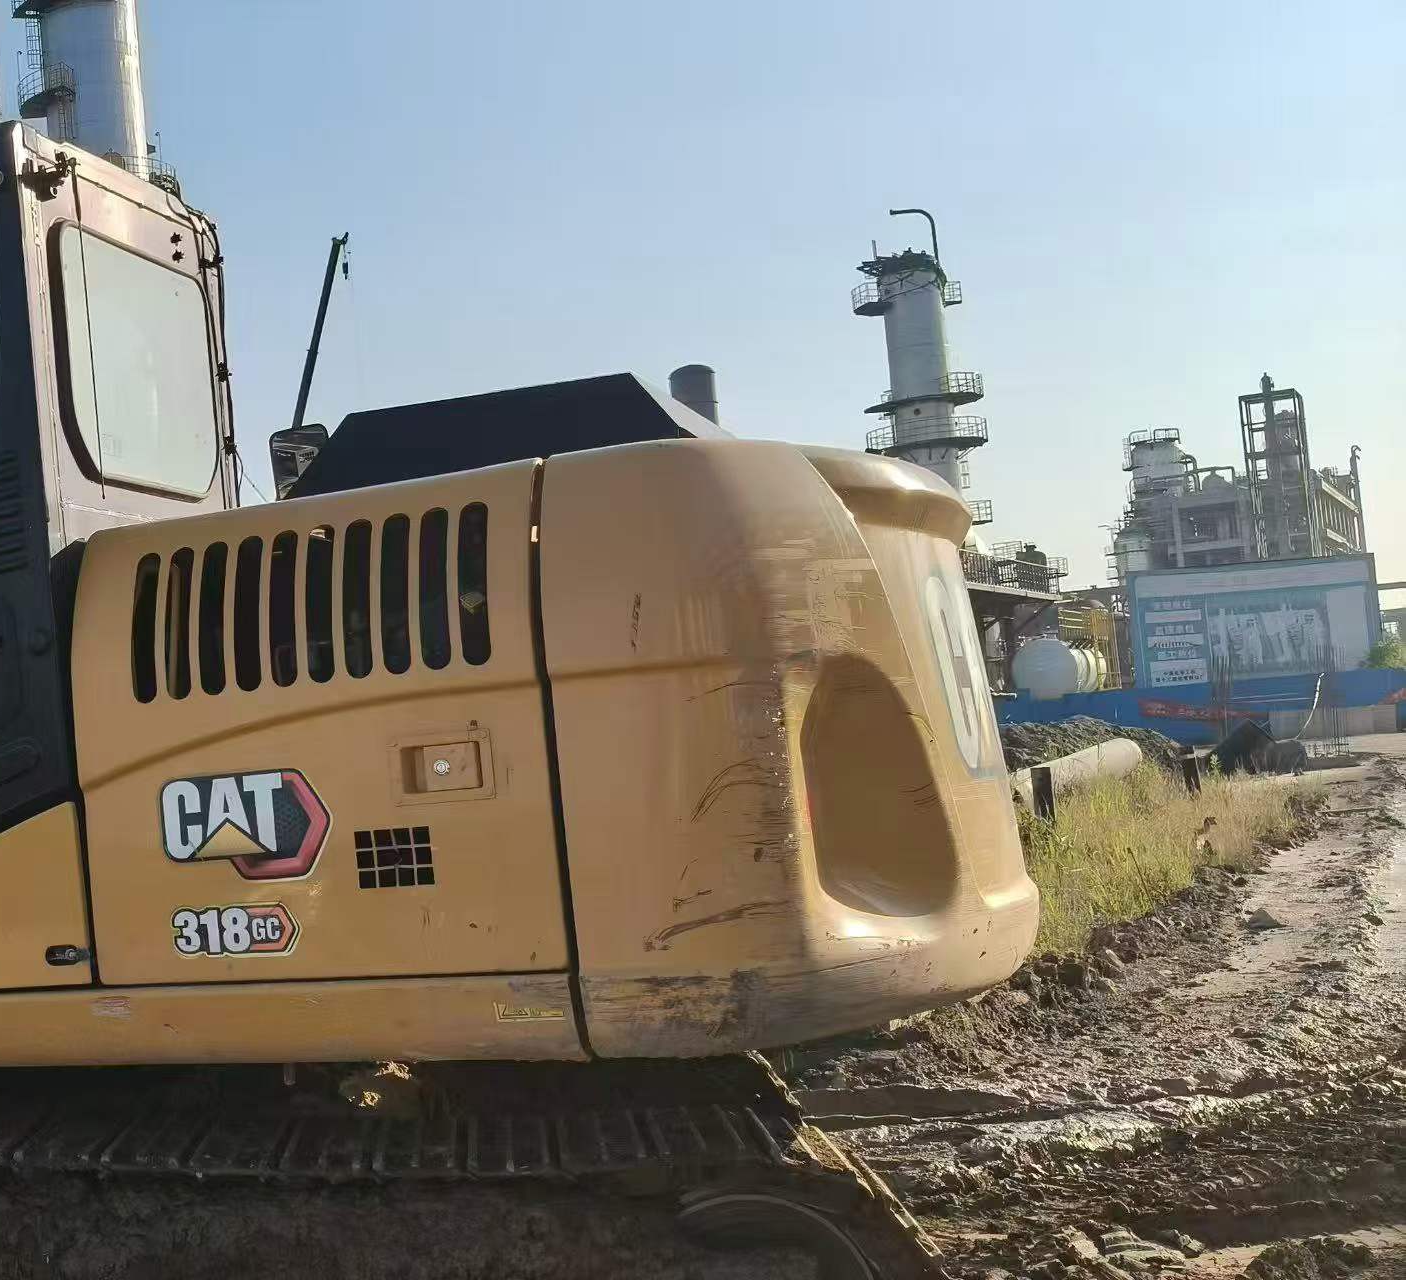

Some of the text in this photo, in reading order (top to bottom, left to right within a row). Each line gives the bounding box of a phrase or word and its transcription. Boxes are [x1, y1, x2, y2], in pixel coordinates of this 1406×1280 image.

[162, 772, 283, 859] CAT
[174, 907, 280, 954] 318 GC
